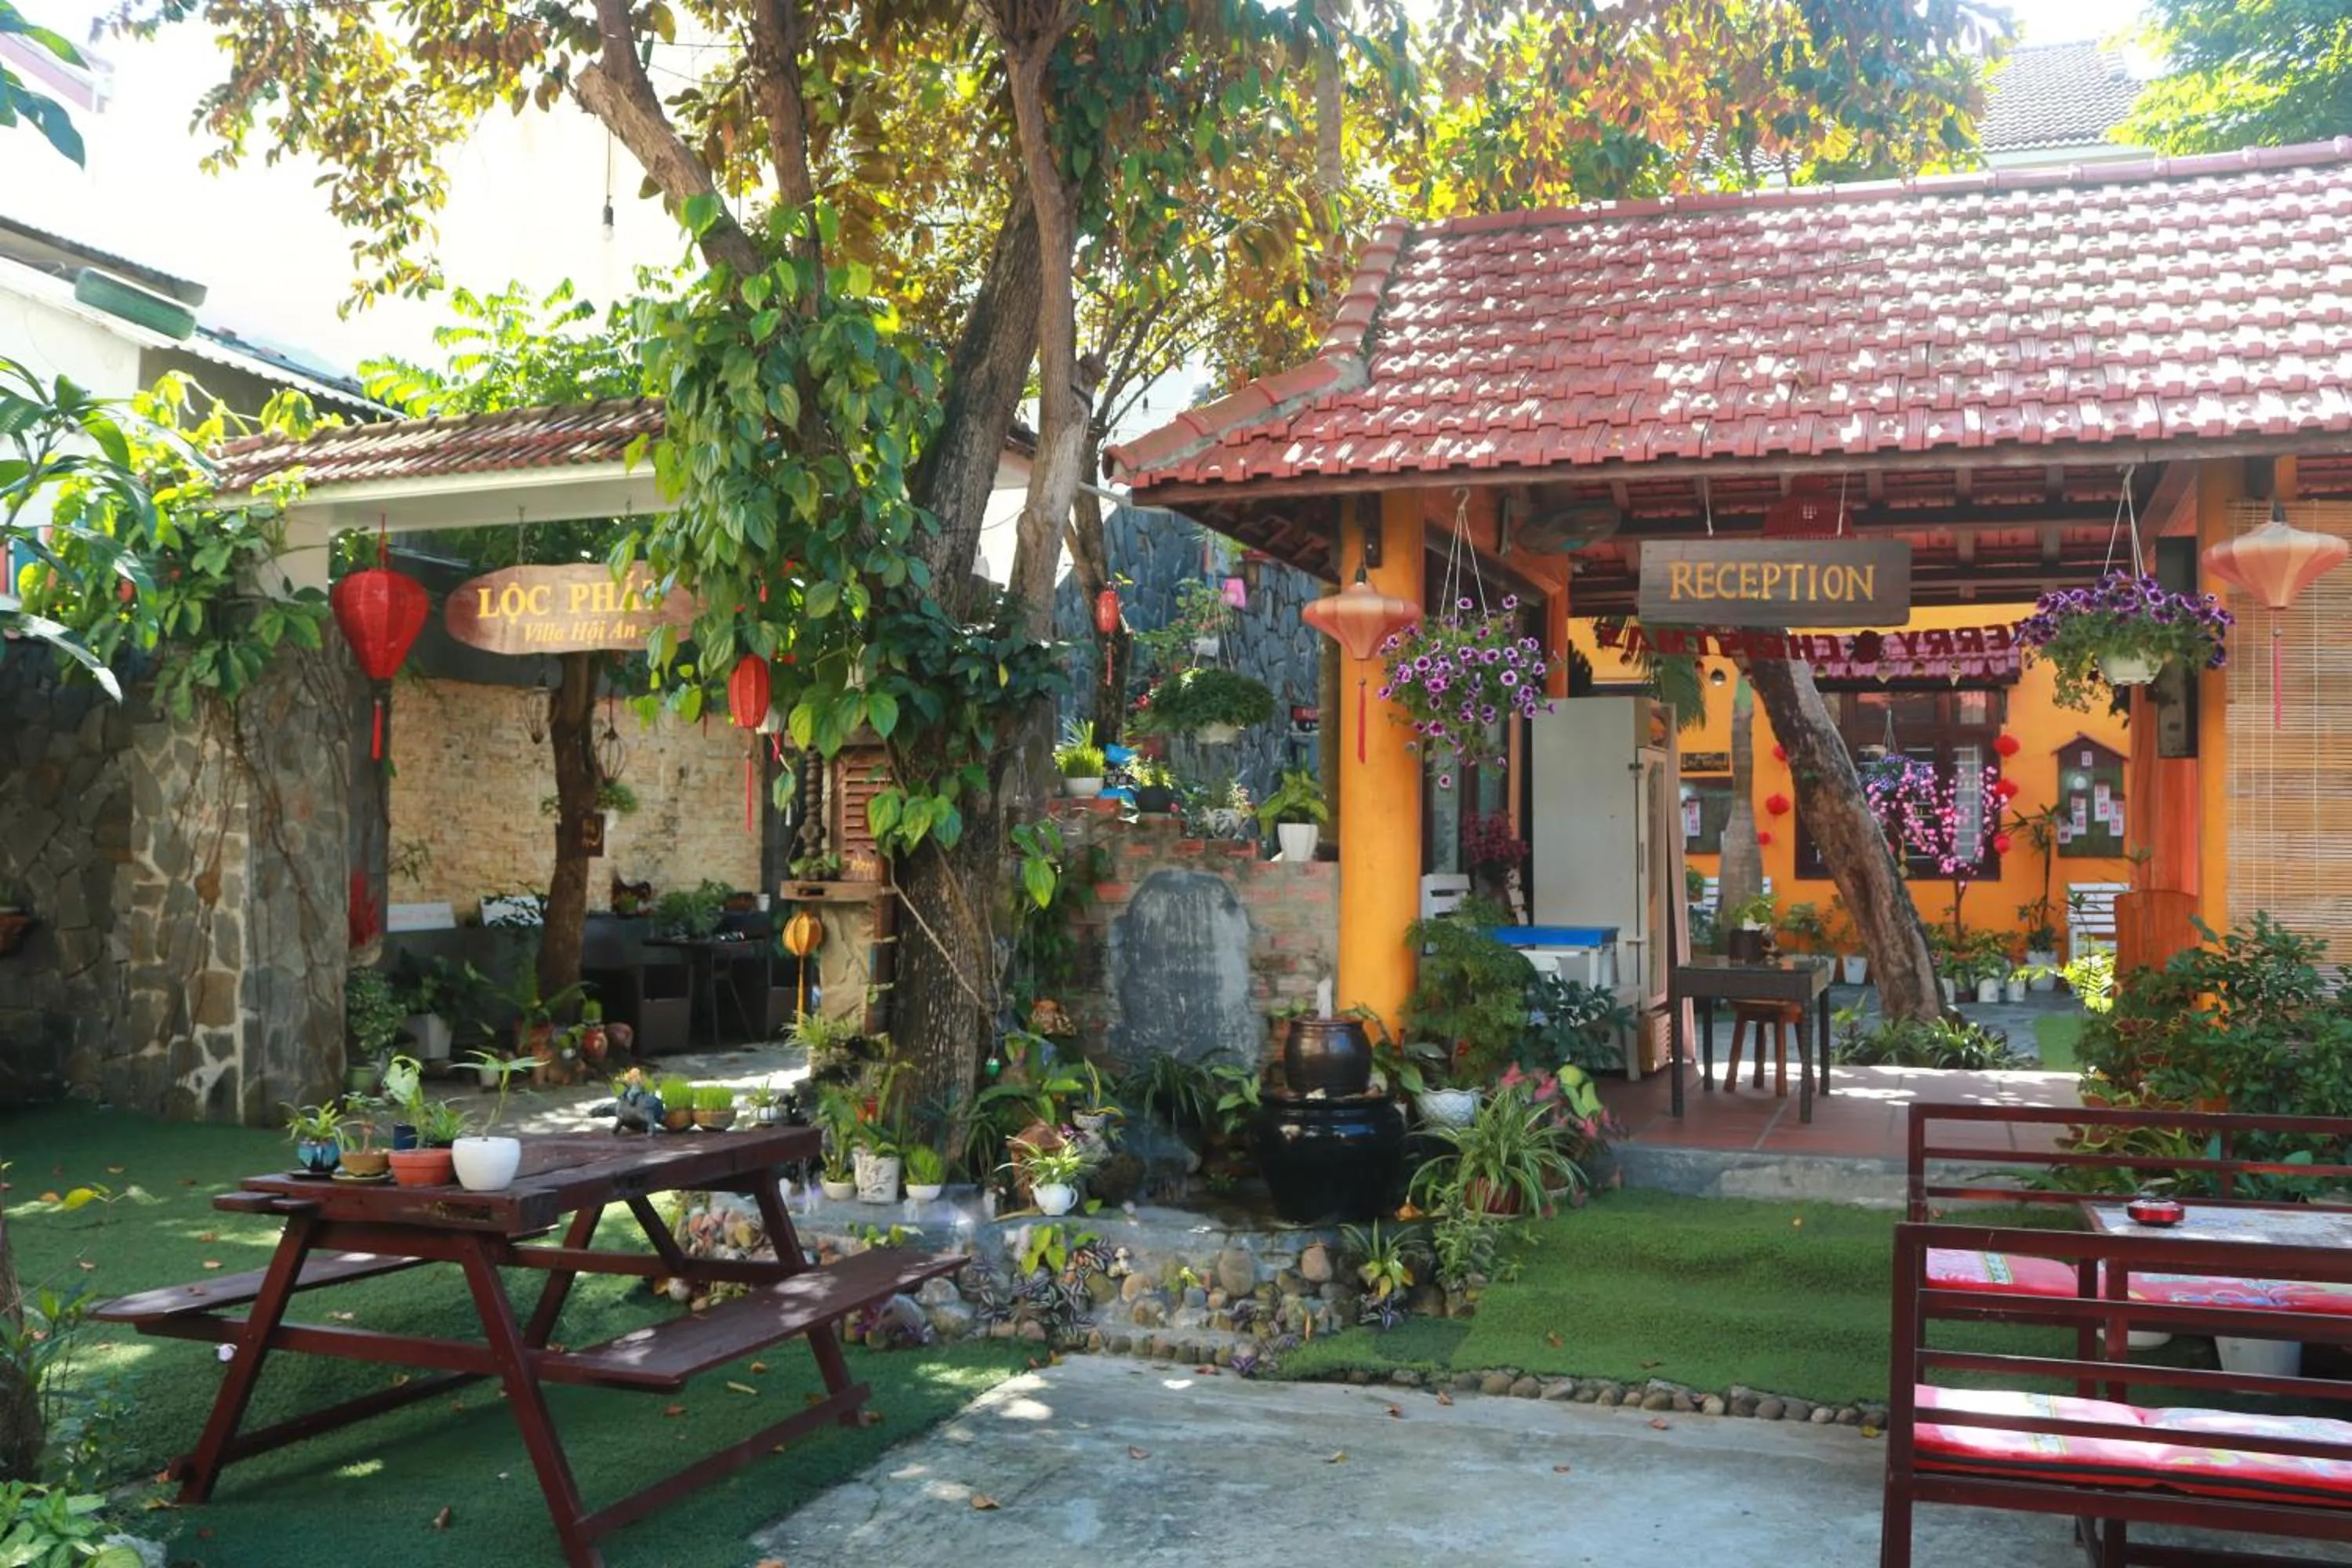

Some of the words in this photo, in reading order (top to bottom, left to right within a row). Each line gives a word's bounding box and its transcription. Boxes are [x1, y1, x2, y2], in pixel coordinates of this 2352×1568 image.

[1669, 562, 1875, 601] RECEPTION
[477, 582, 551, 624] LỘC
[524, 622, 564, 642] Villa
[571, 620, 605, 645] Hội
[608, 619, 637, 639] An
